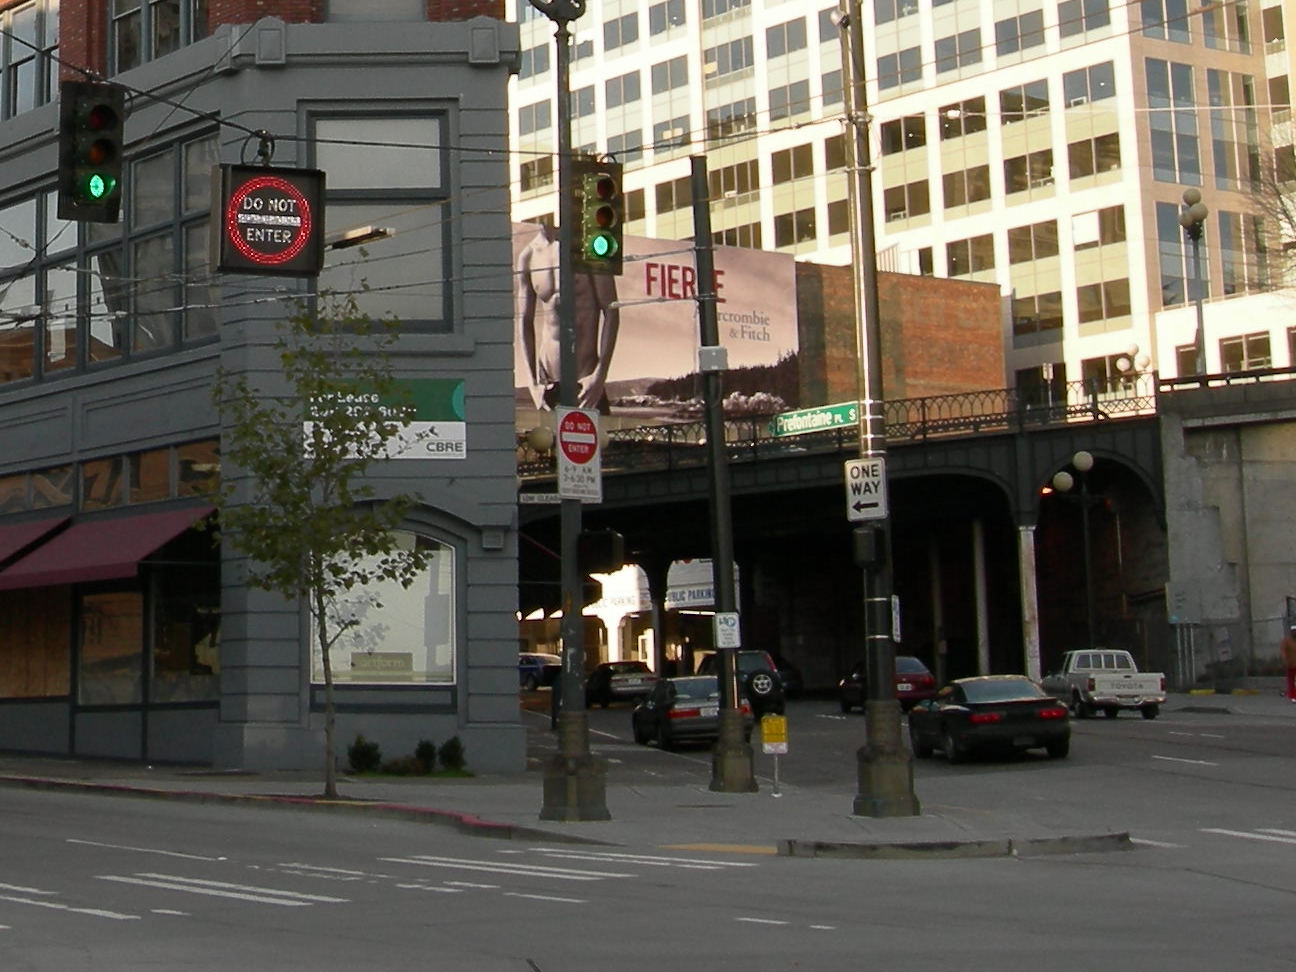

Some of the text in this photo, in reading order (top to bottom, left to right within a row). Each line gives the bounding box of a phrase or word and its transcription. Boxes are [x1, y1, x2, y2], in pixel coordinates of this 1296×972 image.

[244, 197, 296, 212] DO NOT
[246, 228, 292, 244] ENTER
[646, 262, 727, 303] FIERE
[709, 309, 771, 326] rcrombie
[729, 325, 771, 342] & Fitch
[565, 421, 591, 431] DO NOT
[776, 410, 833, 432] Prefontaine
[848, 408, 856, 421] S
[426, 441, 464, 453] CBRE
[568, 444, 589, 454] ENTER
[850, 464, 879, 480] ONE
[850, 481, 881, 496] WAY
[688, 588, 715, 601] PARKIN
